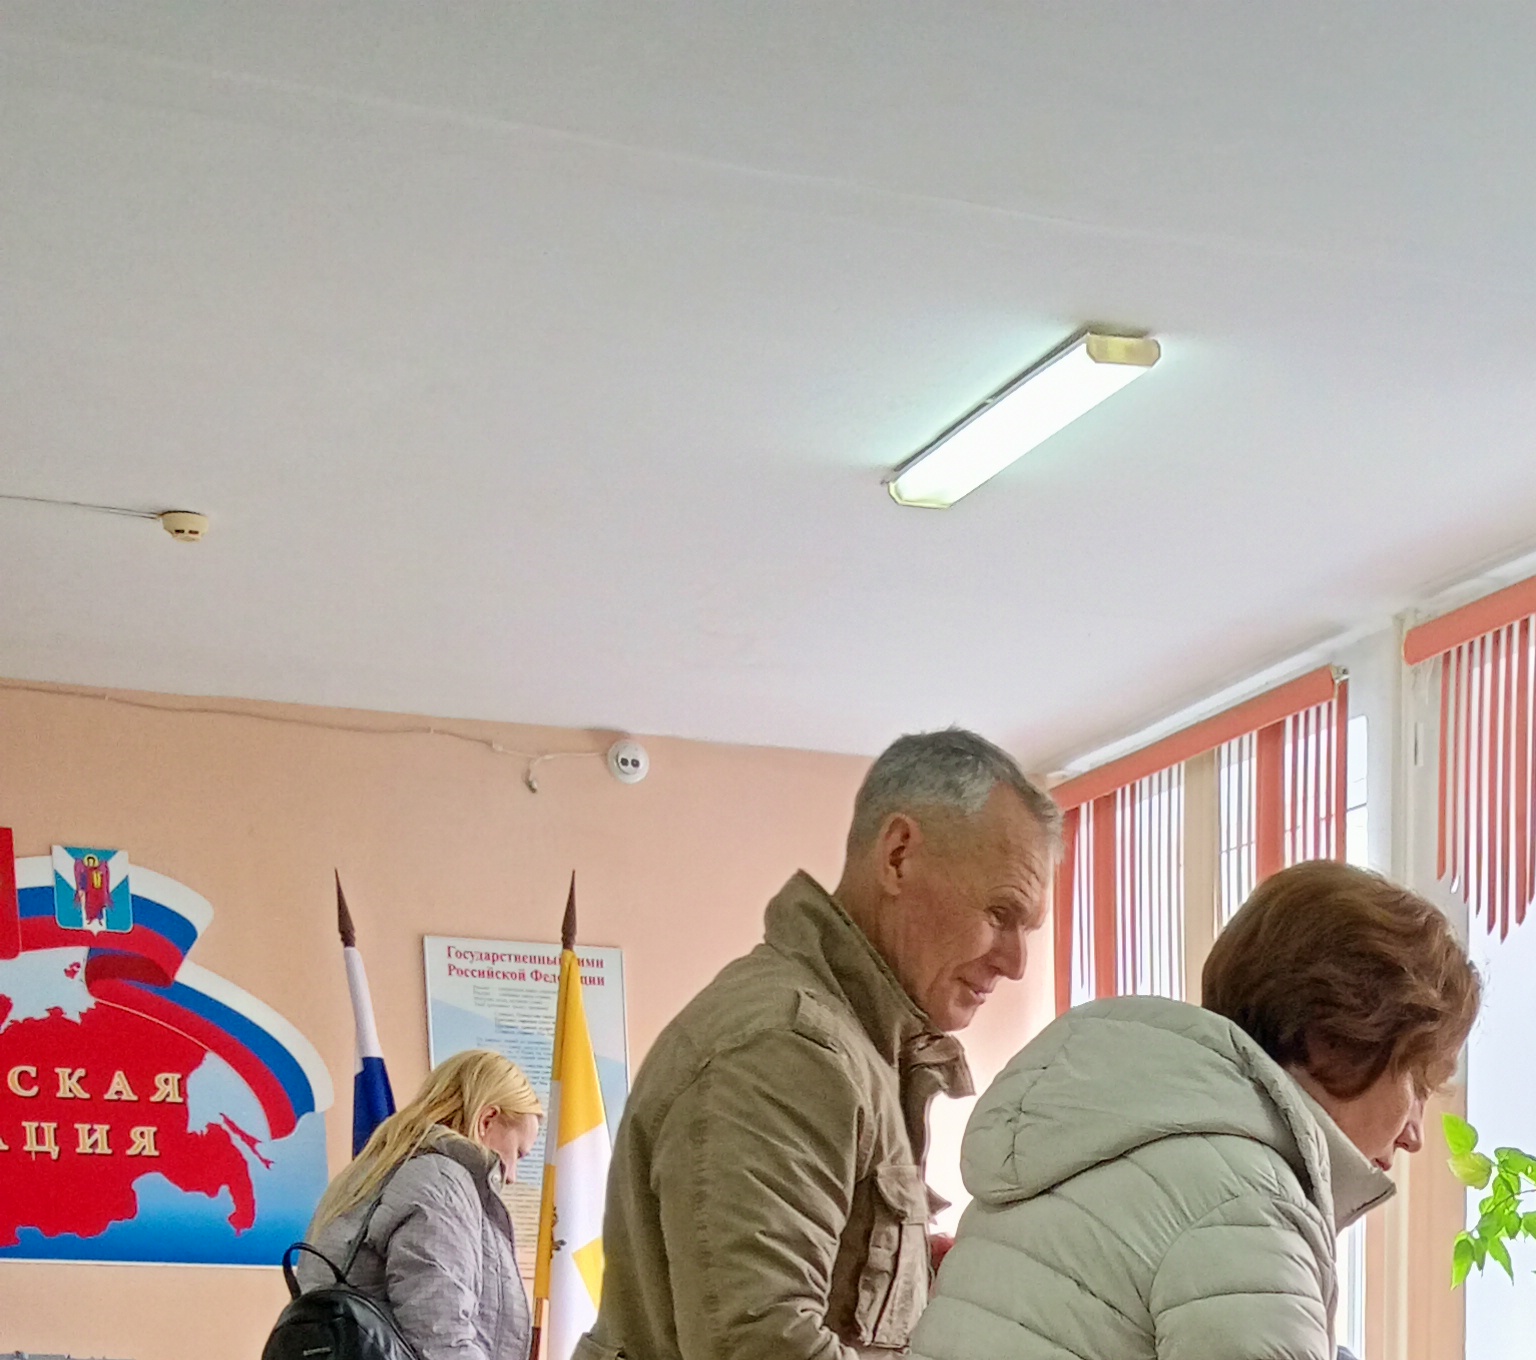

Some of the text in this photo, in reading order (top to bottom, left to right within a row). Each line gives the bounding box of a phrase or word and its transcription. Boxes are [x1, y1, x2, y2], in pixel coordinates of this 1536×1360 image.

[447, 963, 605, 986] Российской Федции
[7, 1065, 184, 1103] СКАЯ
[0, 1120, 160, 1160] ЦИЯ
